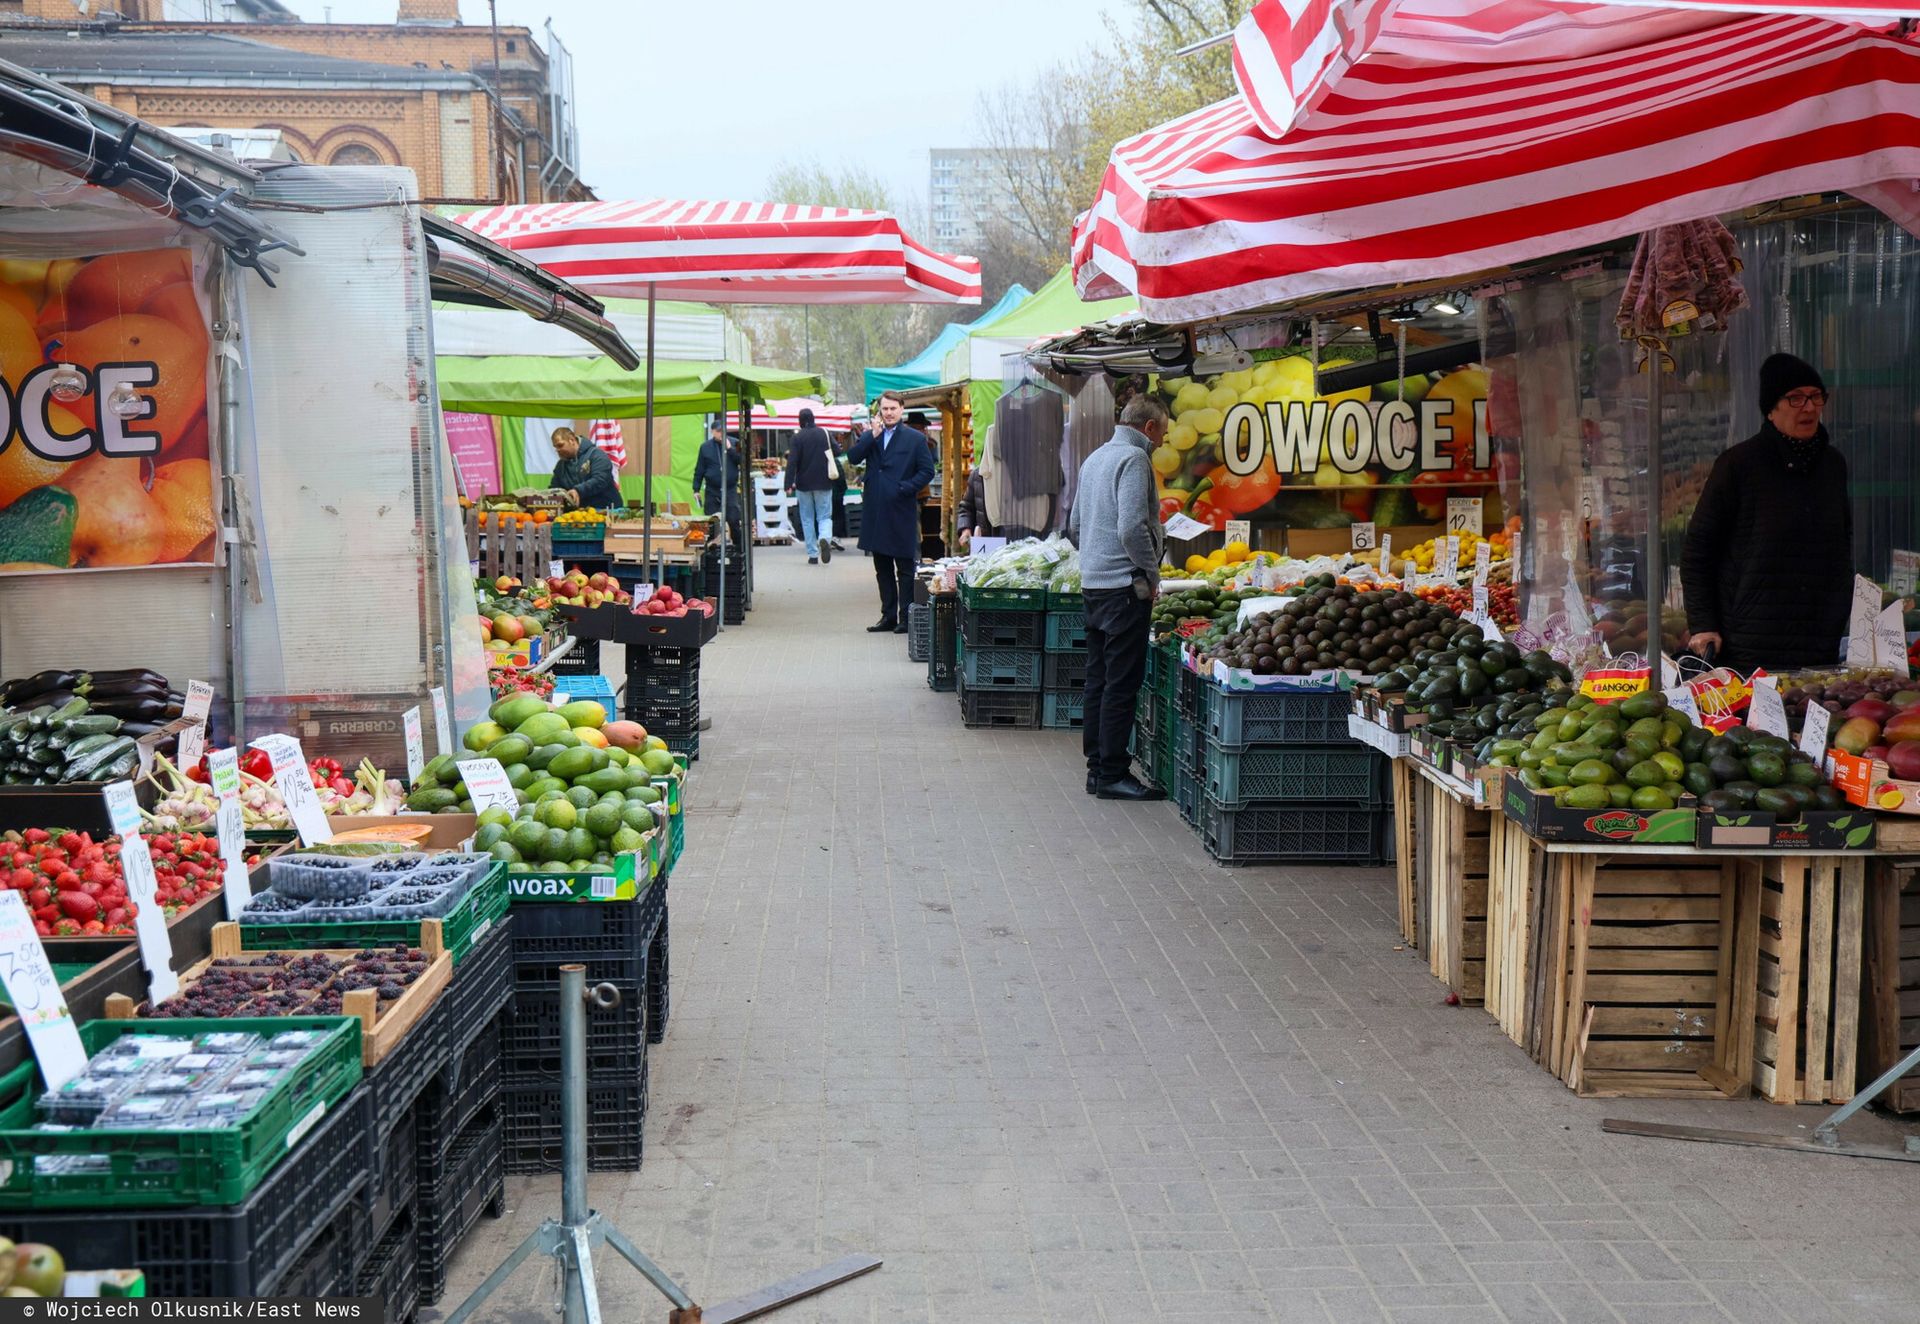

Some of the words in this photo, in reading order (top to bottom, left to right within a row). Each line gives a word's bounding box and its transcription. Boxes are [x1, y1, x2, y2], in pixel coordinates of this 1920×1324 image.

[0, 361, 162, 461] CE
[1223, 401, 1454, 475] OWOCE
[1449, 513, 1467, 531] 12
[1356, 533, 1367, 548] 6
[1298, 679, 1321, 688] UMS
